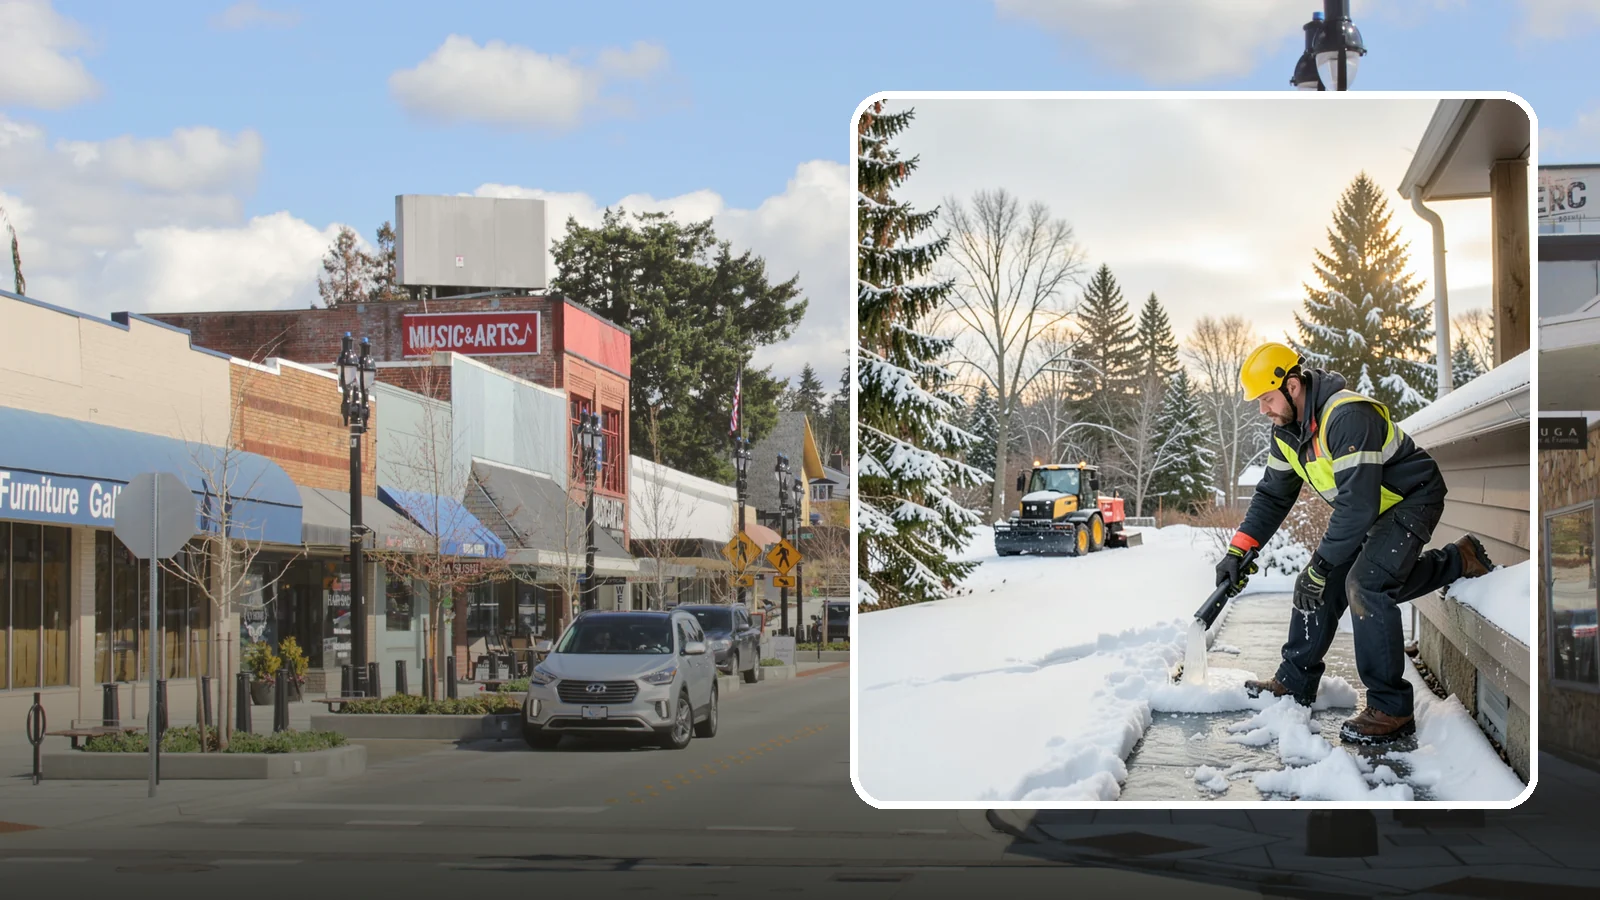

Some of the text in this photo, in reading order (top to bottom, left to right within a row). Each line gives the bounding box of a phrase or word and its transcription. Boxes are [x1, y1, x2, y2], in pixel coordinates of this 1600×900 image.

[409, 322, 520, 349] MUSIC&ARTS
[1540, 427, 1577, 436] UGA
[0, 471, 121, 519] Furniture Gal
[454, 562, 481, 575] SUSHI
